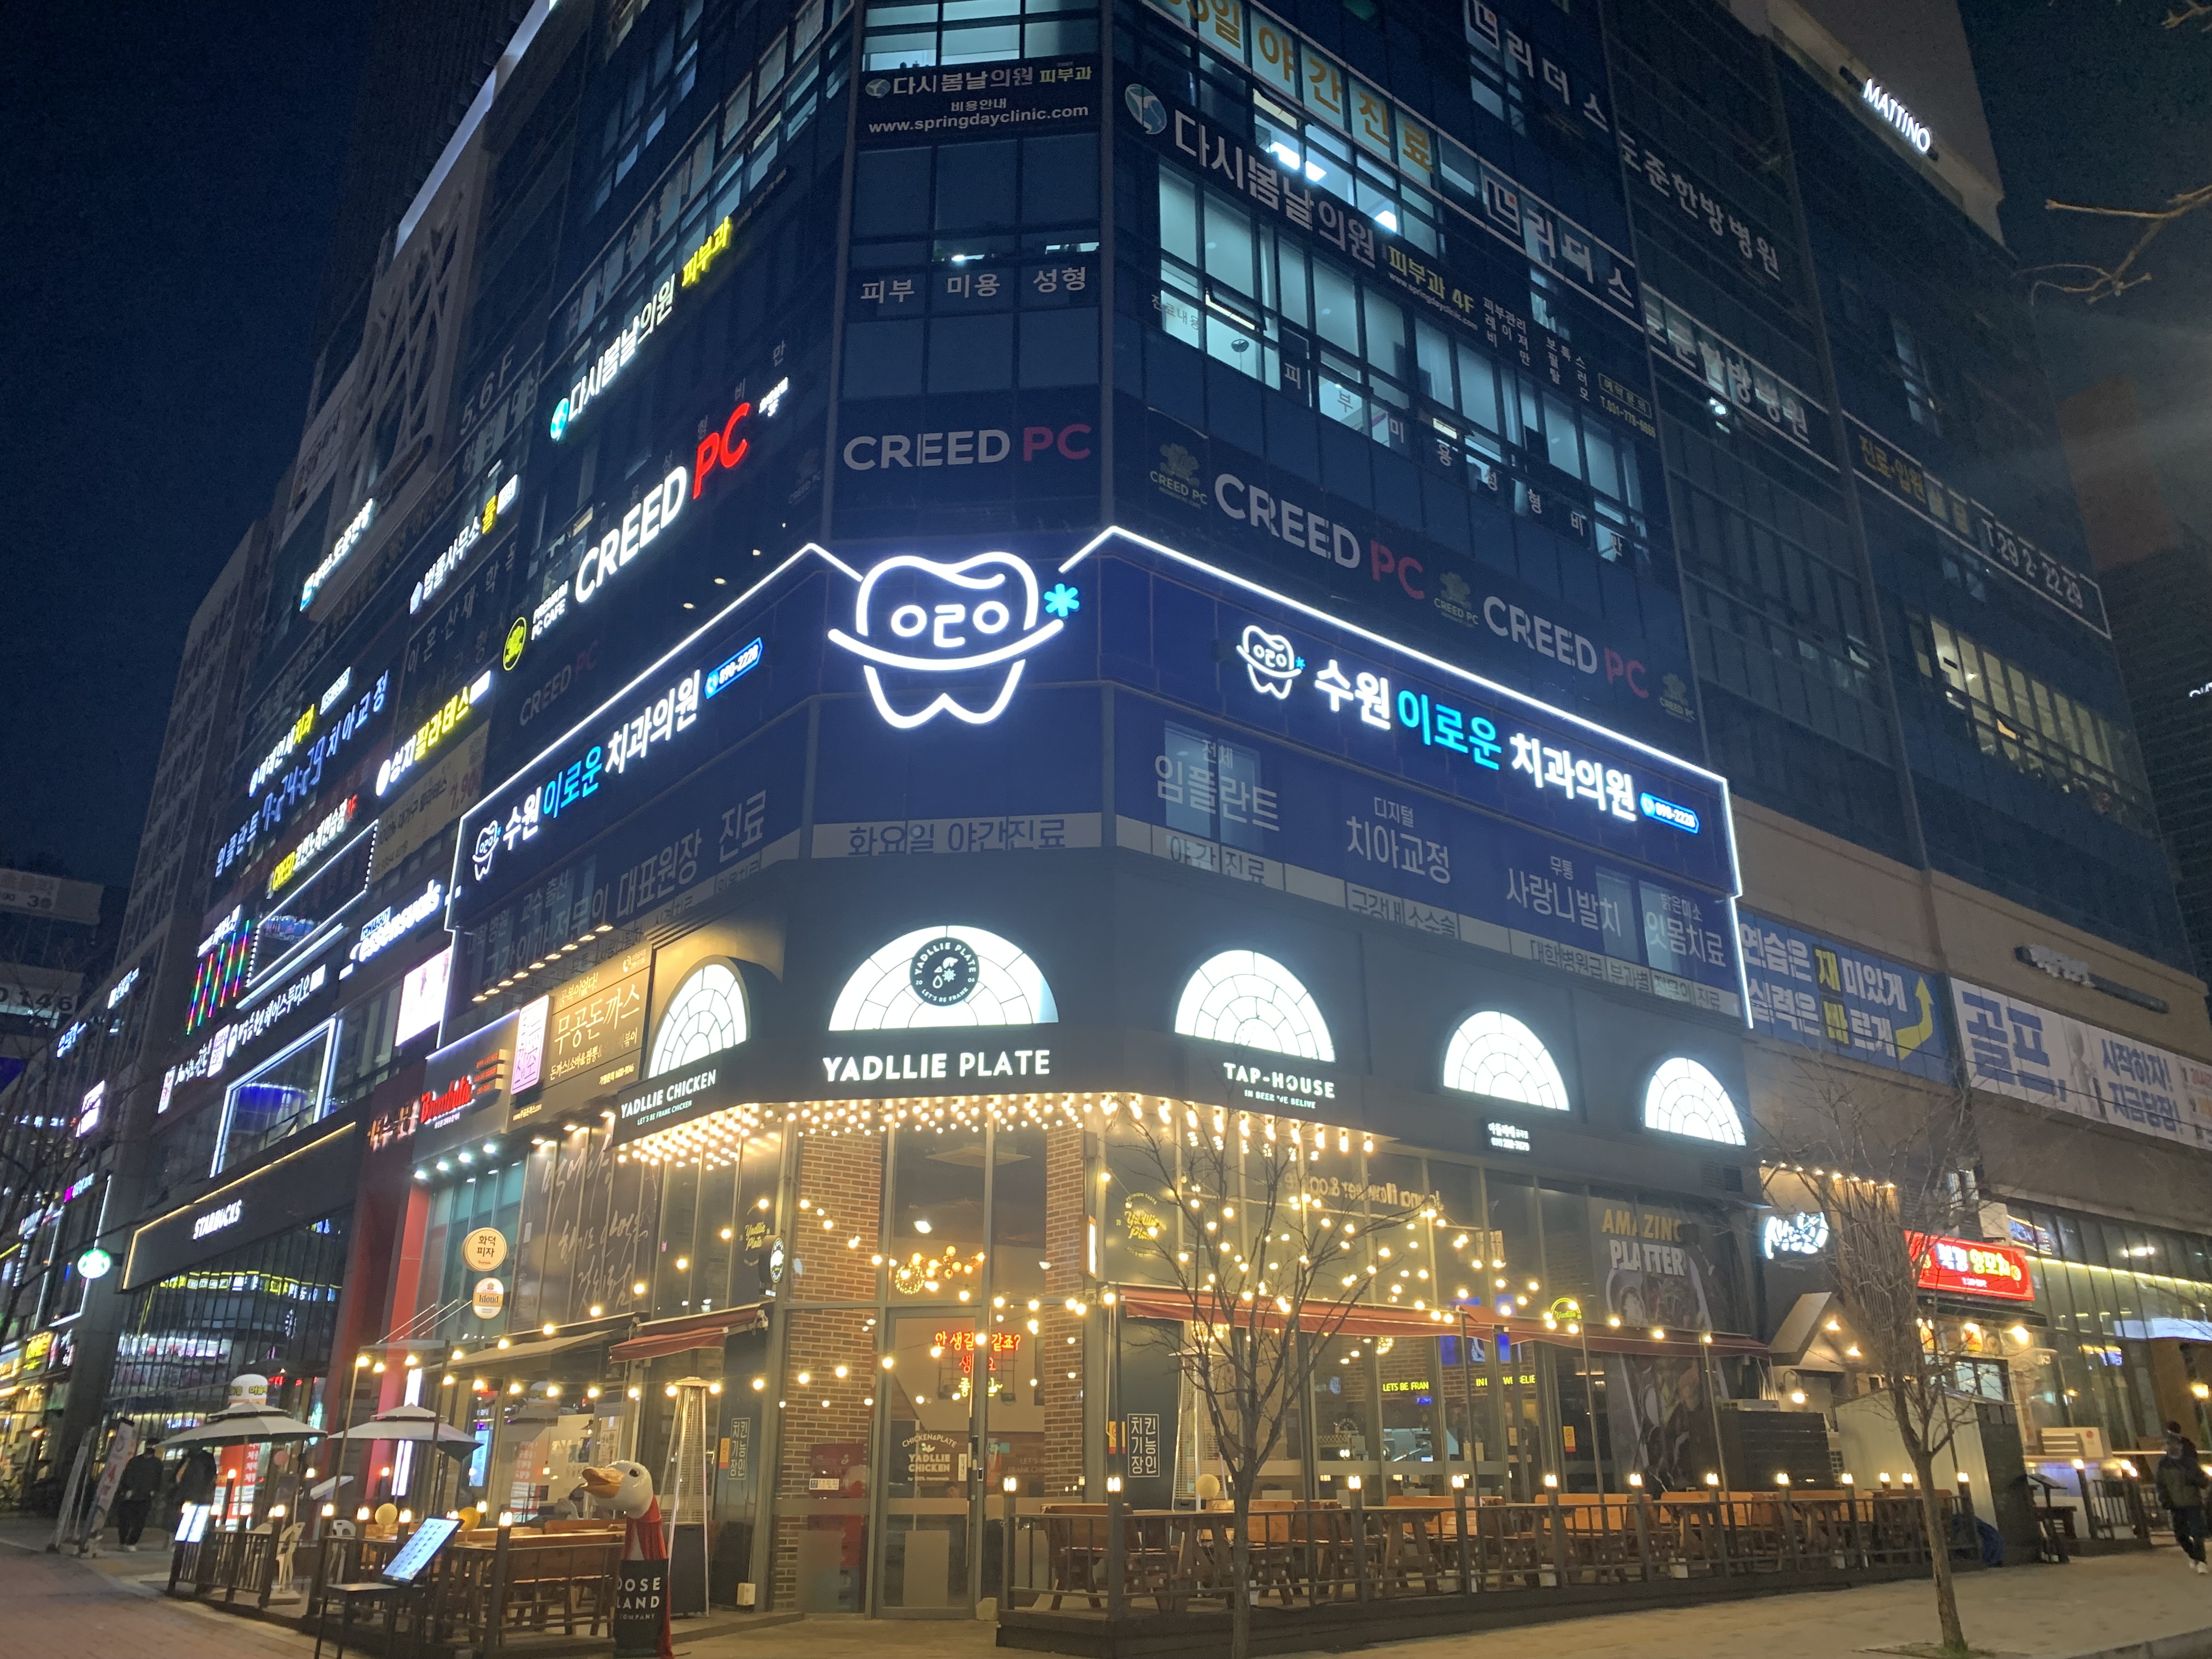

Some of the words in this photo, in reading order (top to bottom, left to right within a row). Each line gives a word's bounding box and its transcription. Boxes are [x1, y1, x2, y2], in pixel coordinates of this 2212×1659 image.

[893, 66, 1033, 96] 다시봄날의원
[1040, 66, 1092, 83] 피부과
[868, 105, 1088, 134] www.springdayclinic.com
[951, 98, 1007, 112] 비용안내
[1864, 78, 1931, 151] MATTINO
[1175, 109, 1375, 269] 다시봄날의원
[1388, 246, 1444, 300] 피부과
[1452, 288, 1475, 313] 4F
[860, 279, 915, 304] 피부
[947, 273, 1000, 298] 미용
[1033, 267, 1086, 293] 성형
[569, 273, 675, 422] 다시봄날의원
[681, 215, 732, 287] 피부과
[844, 430, 1011, 470] CREED
[1023, 424, 1092, 461] PC
[576, 466, 687, 603] CREED
[693, 403, 750, 500] PC
[1150, 471, 1188, 496] CREED
[1192, 492, 1207, 505] PC
[1215, 473, 1361, 568] CREED
[1370, 540, 1425, 600] PC
[423, 516, 481, 600] 법률사무소
[533, 580, 569, 623] PREMIUM
[1434, 597, 1463, 619] CREED
[1466, 614, 1479, 625] PC
[531, 620, 542, 640] PC
[544, 598, 566, 629] CAFE
[1484, 596, 1598, 674] CREED
[1603, 647, 1649, 699] PC
[328, 669, 389, 758] 치아교정
[520, 669, 571, 726] CREED
[1203, 739, 1233, 769] 전체
[1316, 659, 1391, 731] 수원
[1398, 689, 1503, 770] 이로운
[1509, 733, 1637, 822] 치과의원
[503, 786, 541, 851] 수원
[544, 746, 602, 818] 이로운
[605, 669, 701, 774] 치과의원
[1155, 755, 1280, 832] 임플란트
[1374, 797, 1414, 828] 디지털
[617, 829, 702, 919] 대표원장
[718, 789, 766, 863] 진료
[848, 826, 934, 856] 화요일
[1346, 816, 1451, 884] 치아교정
[1550, 856, 1573, 881] 무통
[1506, 868, 1622, 938] 사랑니발치
[1645, 911, 1726, 967] 잇몸치료
[914, 942, 951, 975] YADLLIE
[955, 945, 977, 973] PLATE
[1740, 923, 1812, 983] 연습은
[1815, 947, 1907, 1012] 재미있게
[921, 989, 937, 1002] LET'S
[949, 987, 969, 1001] FRANK
[554, 984, 640, 1055] 무공돈까스
[1748, 978, 1821, 1037] 실력은
[1822, 1000, 1896, 1058] 빠르게
[822, 1054, 947, 1082] YADLLIE
[960, 1049, 1050, 1077] PLATE
[1223, 1062, 1335, 1098] TAP-HOUSE
[621, 1089, 663, 1119] YADLLIE
[667, 1069, 716, 1102] CHICKEN
[1255, 1091, 1274, 1101] BEER
[1290, 1097, 1316, 1109] BELIVE
[637, 1114, 649, 1126] LET'S
[656, 1107, 671, 1119] FRANK
[672, 1100, 692, 1114] CHICKEN
[193, 1199, 242, 1240] STARBUCKS
[477, 1234, 496, 1245] 화덕
[477, 1245, 494, 1257] 피자
[1610, 1239, 1685, 1277] PLATTER
[478, 1293, 499, 1305] Kloud
[935, 1331, 947, 1349] 안
[950, 1331, 974, 1351] 생길
[991, 1334, 1021, 1351] 같죠?
[1383, 1383, 1398, 1391] LETS
[1400, 1383, 1409, 1391] BE
[1410, 1382, 1429, 1391] FRAN
[732, 1421, 748, 1438] 치킨
[902, 1434, 957, 1448] CHICKEN&PLATE
[1131, 1417, 1156, 1434] 치킨
[732, 1441, 746, 1457] 기능
[909, 1454, 950, 1463] YADLLIE
[1131, 1437, 1156, 1454] 기능
[730, 1459, 745, 1476] 장인
[909, 1463, 950, 1472] CHICKEN
[1131, 1455, 1156, 1475] 장인
